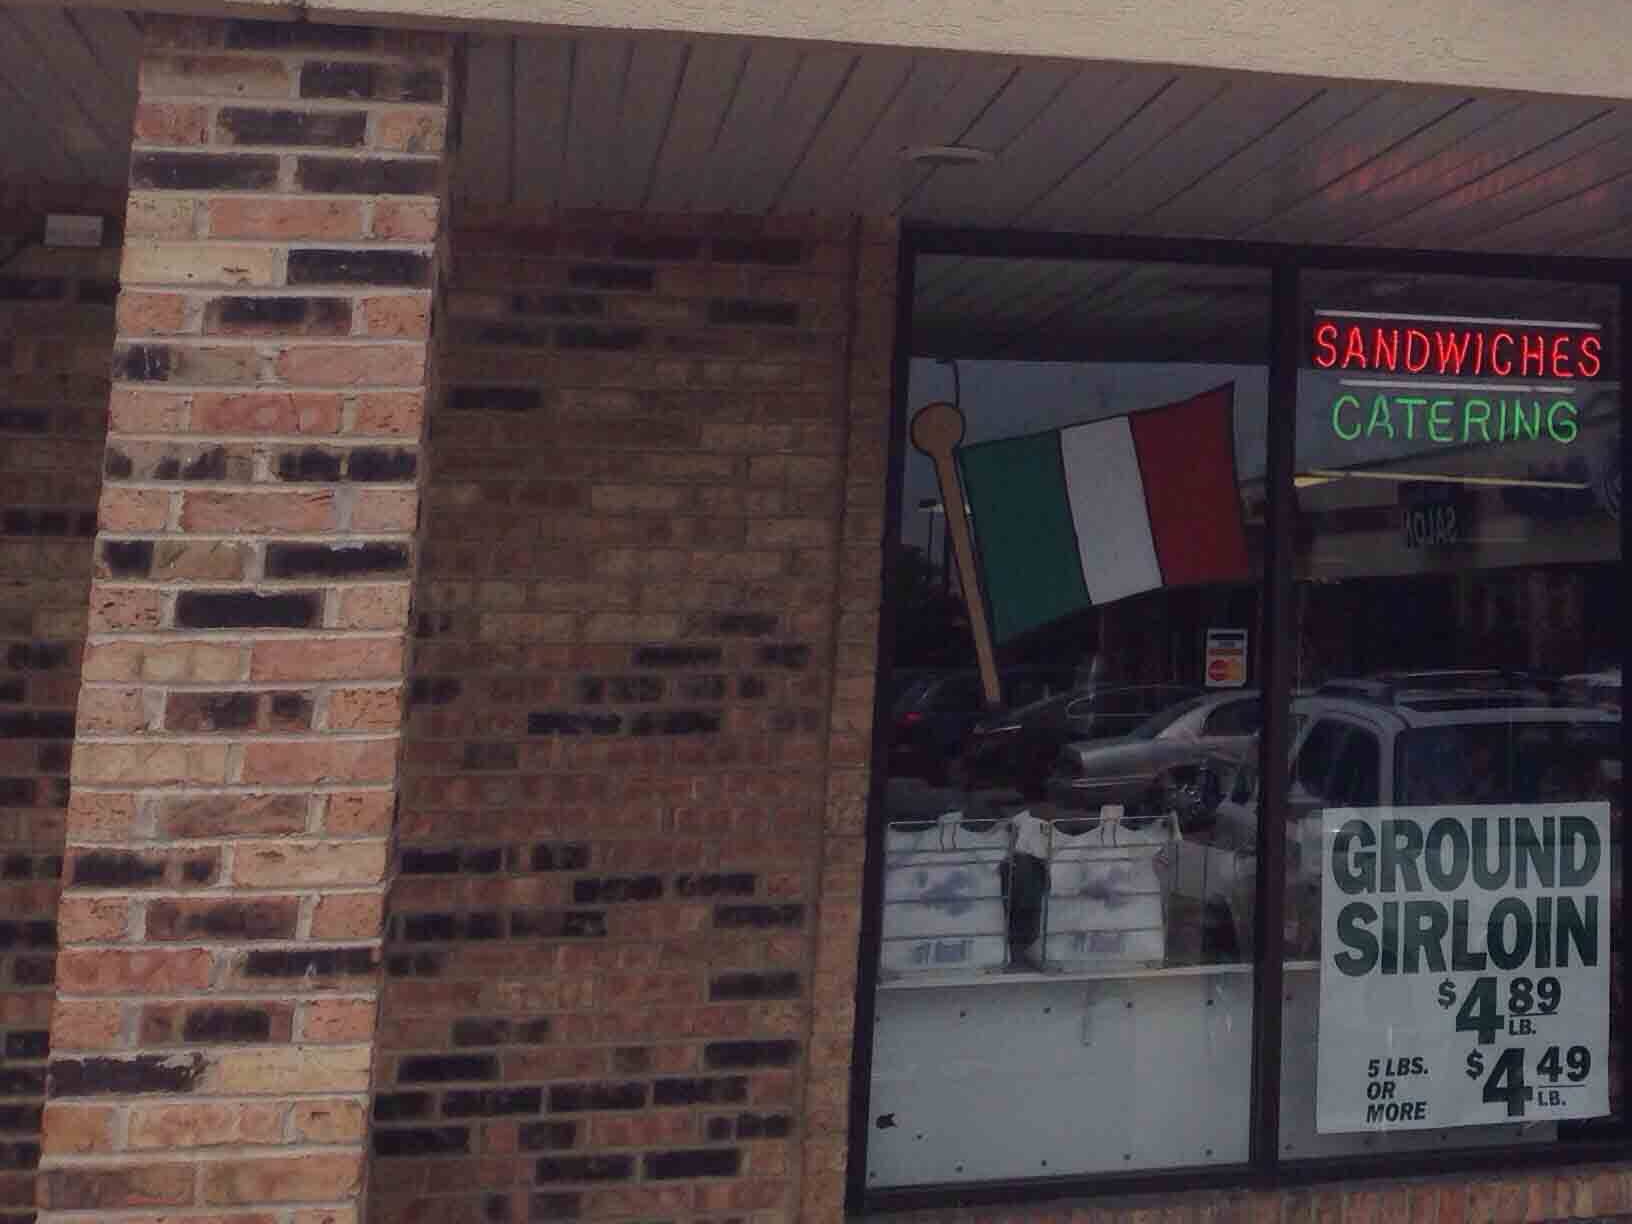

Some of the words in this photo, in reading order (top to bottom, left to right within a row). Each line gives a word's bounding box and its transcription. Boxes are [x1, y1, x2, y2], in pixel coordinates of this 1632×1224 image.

[1314, 323, 1601, 378] SANDWICHES
[1333, 395, 1578, 444] CATERING
[1332, 816, 1600, 894] GROUND
[1334, 896, 1599, 976] SIRLOIN
[1367, 1060, 1380, 1077] 5
[1386, 1058, 1429, 1075] LBS.
[1367, 1082, 1395, 1100] OR
[1367, 1102, 1426, 1123] MORE
